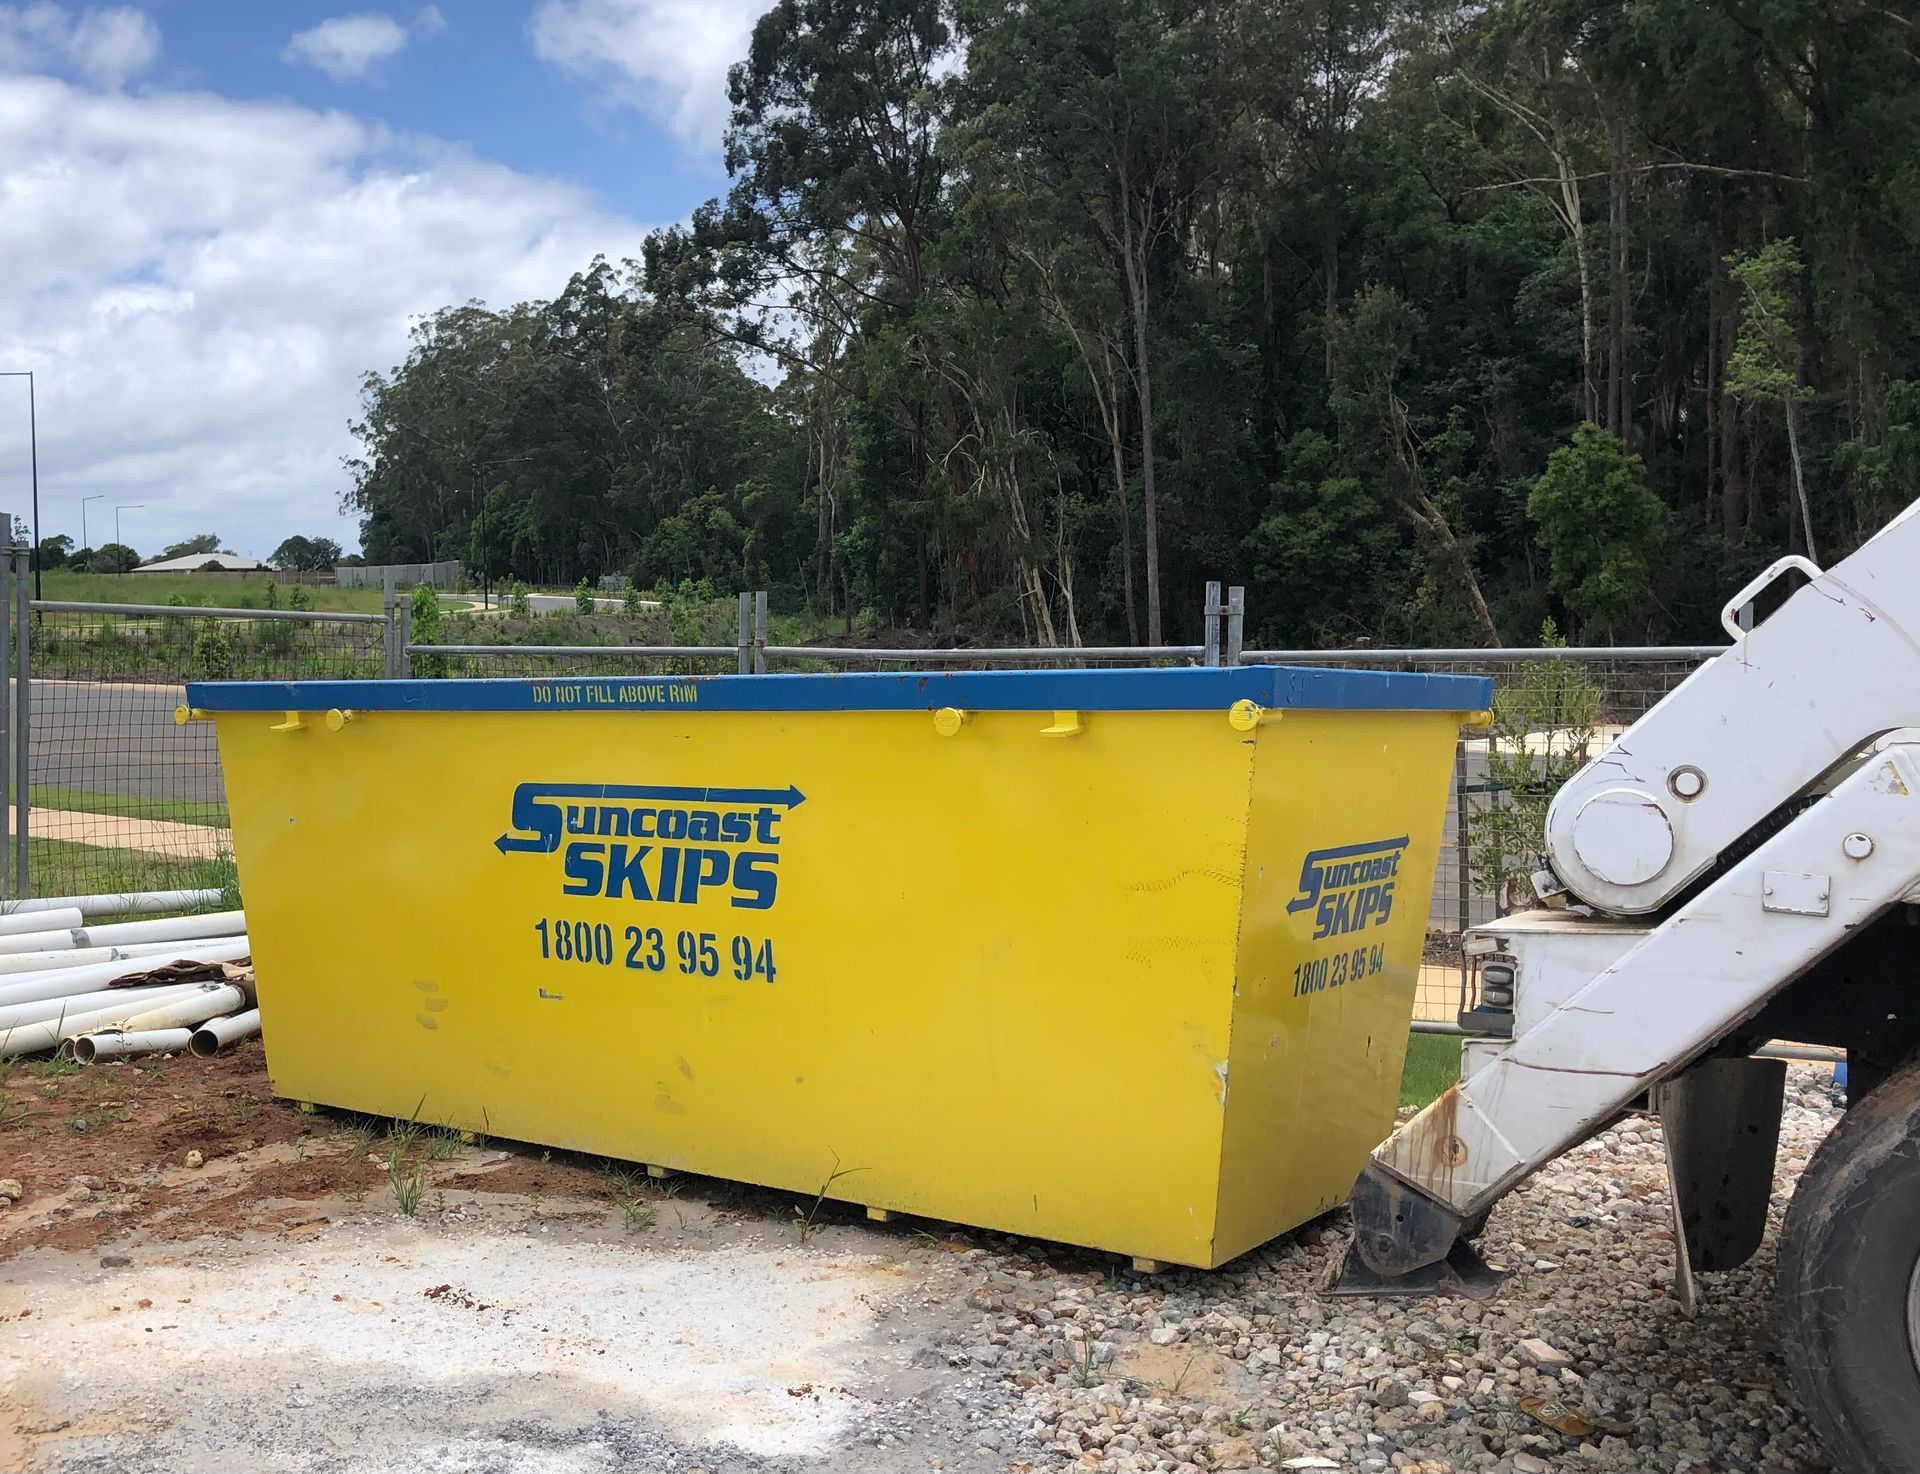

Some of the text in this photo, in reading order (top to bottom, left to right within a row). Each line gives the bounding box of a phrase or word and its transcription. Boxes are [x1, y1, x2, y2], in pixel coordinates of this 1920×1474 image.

[533, 684, 698, 703] DO NOT FILL ABOVE RIM
[494, 782, 783, 854] Suncoast
[563, 842, 779, 910] SKIPS
[1287, 836, 1403, 912] Suncoast
[1312, 881, 1396, 940] SKIPS
[534, 917, 776, 983] 1800 23 95 94
[1293, 942, 1384, 997] 1800 23 95 94
